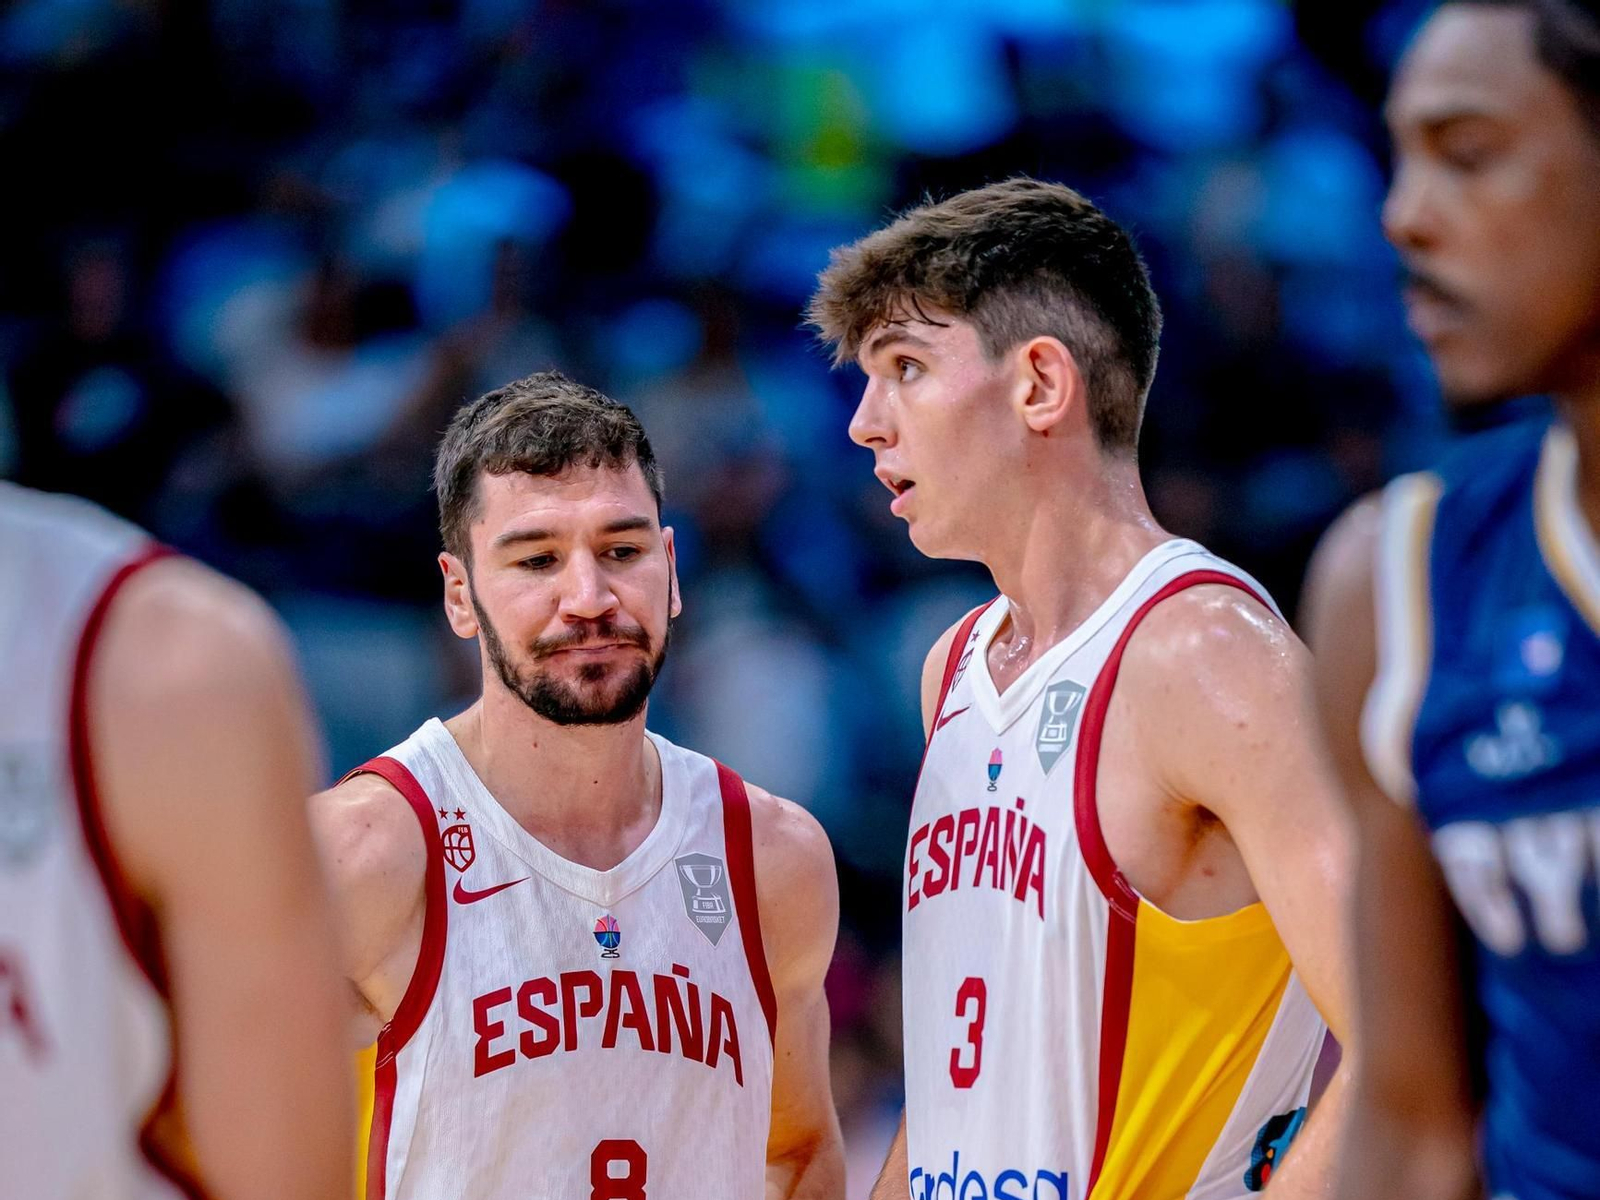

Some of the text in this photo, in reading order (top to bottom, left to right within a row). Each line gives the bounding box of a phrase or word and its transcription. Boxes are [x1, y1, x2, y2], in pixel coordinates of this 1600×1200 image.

[908, 797, 1046, 922] ESPAÑA
[473, 963, 743, 1087] ESPAÑA
[950, 977, 986, 1088] 3
